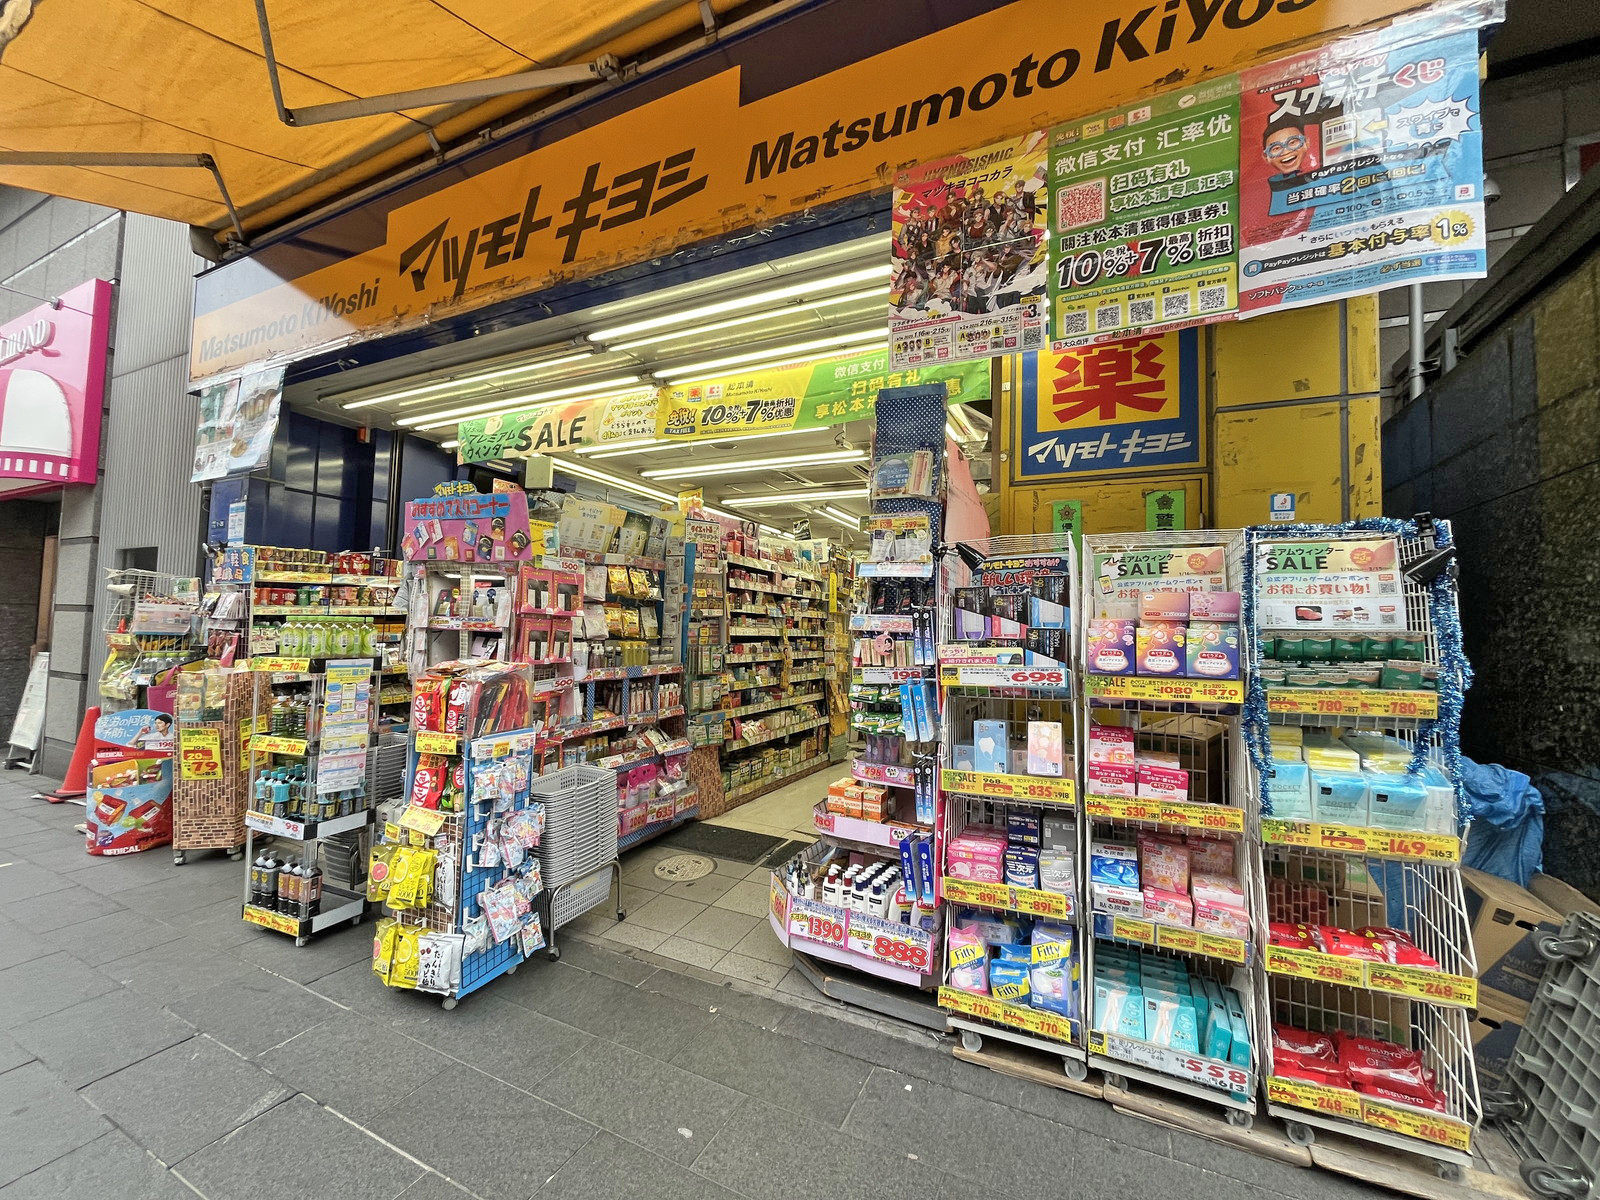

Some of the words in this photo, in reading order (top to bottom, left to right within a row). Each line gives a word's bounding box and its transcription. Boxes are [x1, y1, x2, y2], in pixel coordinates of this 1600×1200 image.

[1393, 58, 1446, 89] くじ
[744, 48, 1081, 185] Matsumoto
[1055, 136, 1146, 177] 微信支付
[1156, 113, 1232, 151] 汇率优
[921, 165, 1014, 199] マツキヨココカラ
[1110, 158, 1190, 194] 扫码有礼
[1110, 170, 1234, 212] 享松本清专属汇率
[199, 313, 298, 364] Matsumoto
[834, 359, 885, 379] 微信支付
[514, 416, 587, 452] SALE
[1028, 428, 1192, 469] マツモトキヨシ
[1117, 561, 1170, 577] SALE
[1266, 556, 1329, 570] SALE
[1266, 583, 1371, 596] お得にお買い物!
[1011, 671, 1064, 683] 698
[1103, 677, 1126, 688] SALE
[1318, 700, 1343, 712] 780
[1390, 701, 1417, 714] 780
[191, 761, 219, 772] 79
[958, 773, 977, 783] SALE
[1028, 784, 1053, 798] 835
[1125, 806, 1146, 818] 530
[284, 822, 299, 833] 98
[1203, 814, 1226, 827] 1560
[1283, 822, 1311, 835] SALE
[1389, 838, 1427, 856] 149
[979, 891, 997, 904] 891
[1033, 900, 1053, 913] 891
[808, 915, 844, 943] 1390
[874, 935, 929, 968] 888
[954, 946, 977, 962] Fitty
[1036, 942, 1061, 958] Fitty
[1317, 965, 1342, 979] 238
[996, 984, 1020, 997] Fitty
[1425, 982, 1453, 996] 248
[972, 1002, 990, 1016] 770
[1040, 1020, 1058, 1035] 770
[1186, 1059, 1247, 1085] 558
[1318, 1097, 1342, 1112] 248
[1420, 1124, 1448, 1141] 248
